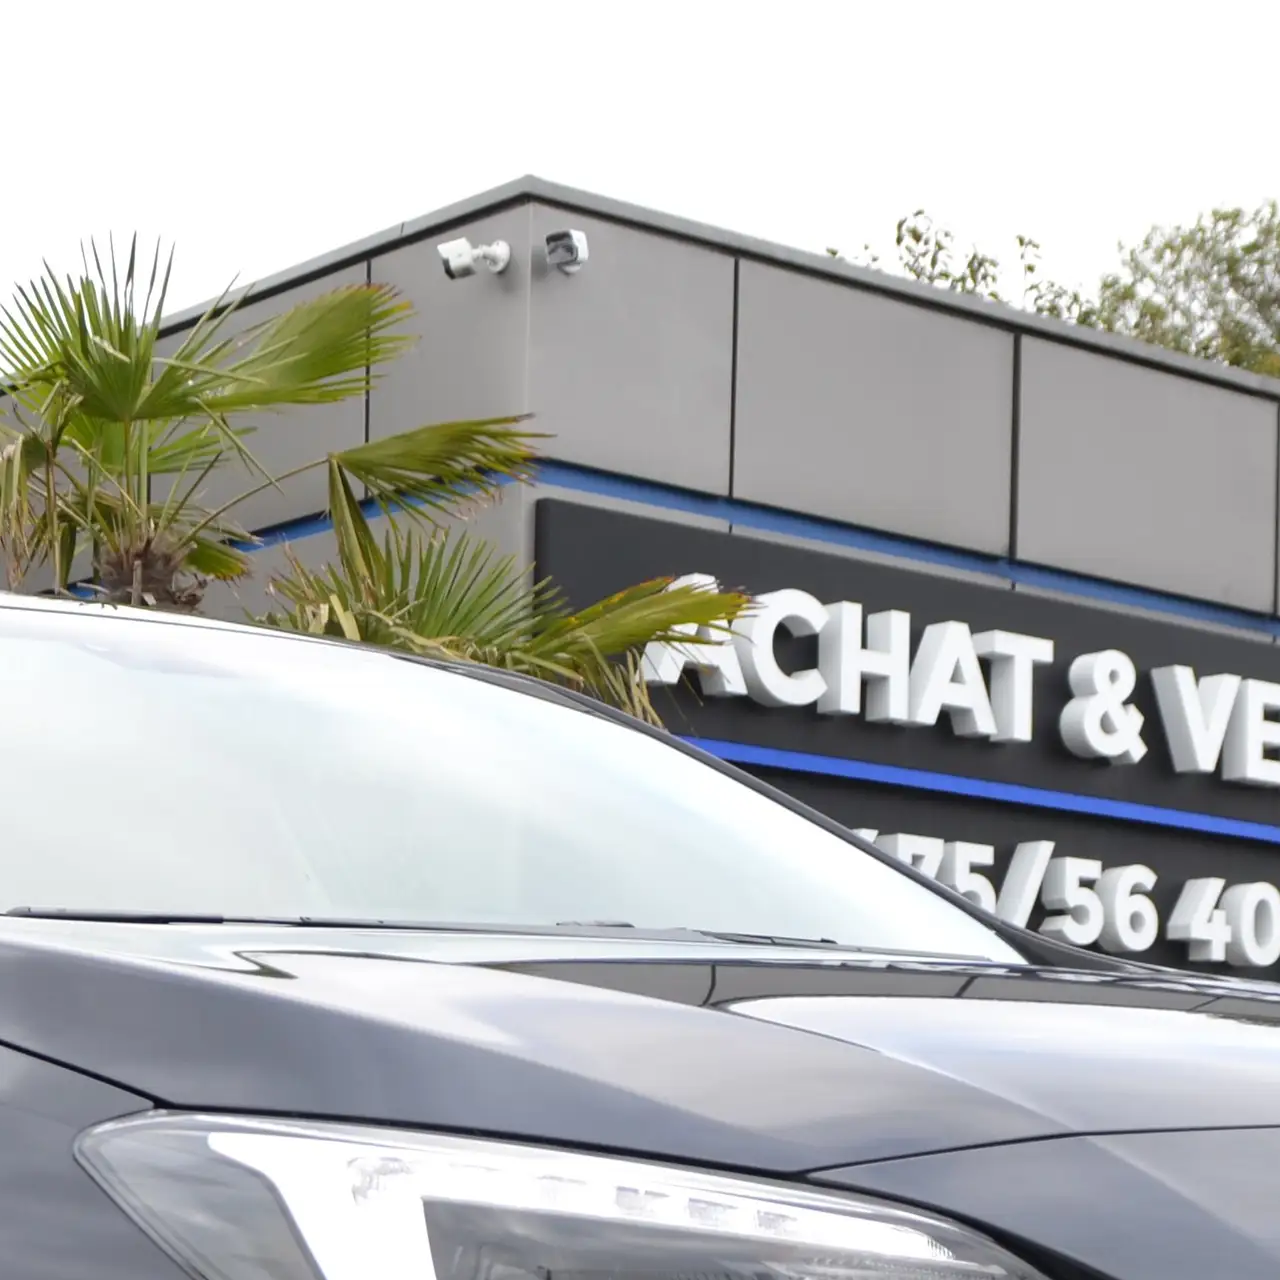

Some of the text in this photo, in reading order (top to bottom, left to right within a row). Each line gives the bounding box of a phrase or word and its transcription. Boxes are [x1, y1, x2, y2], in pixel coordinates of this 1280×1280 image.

[636, 572, 1054, 744] ACHAT
[1060, 648, 1149, 765] &
[851, 828, 1159, 953] 75/56
